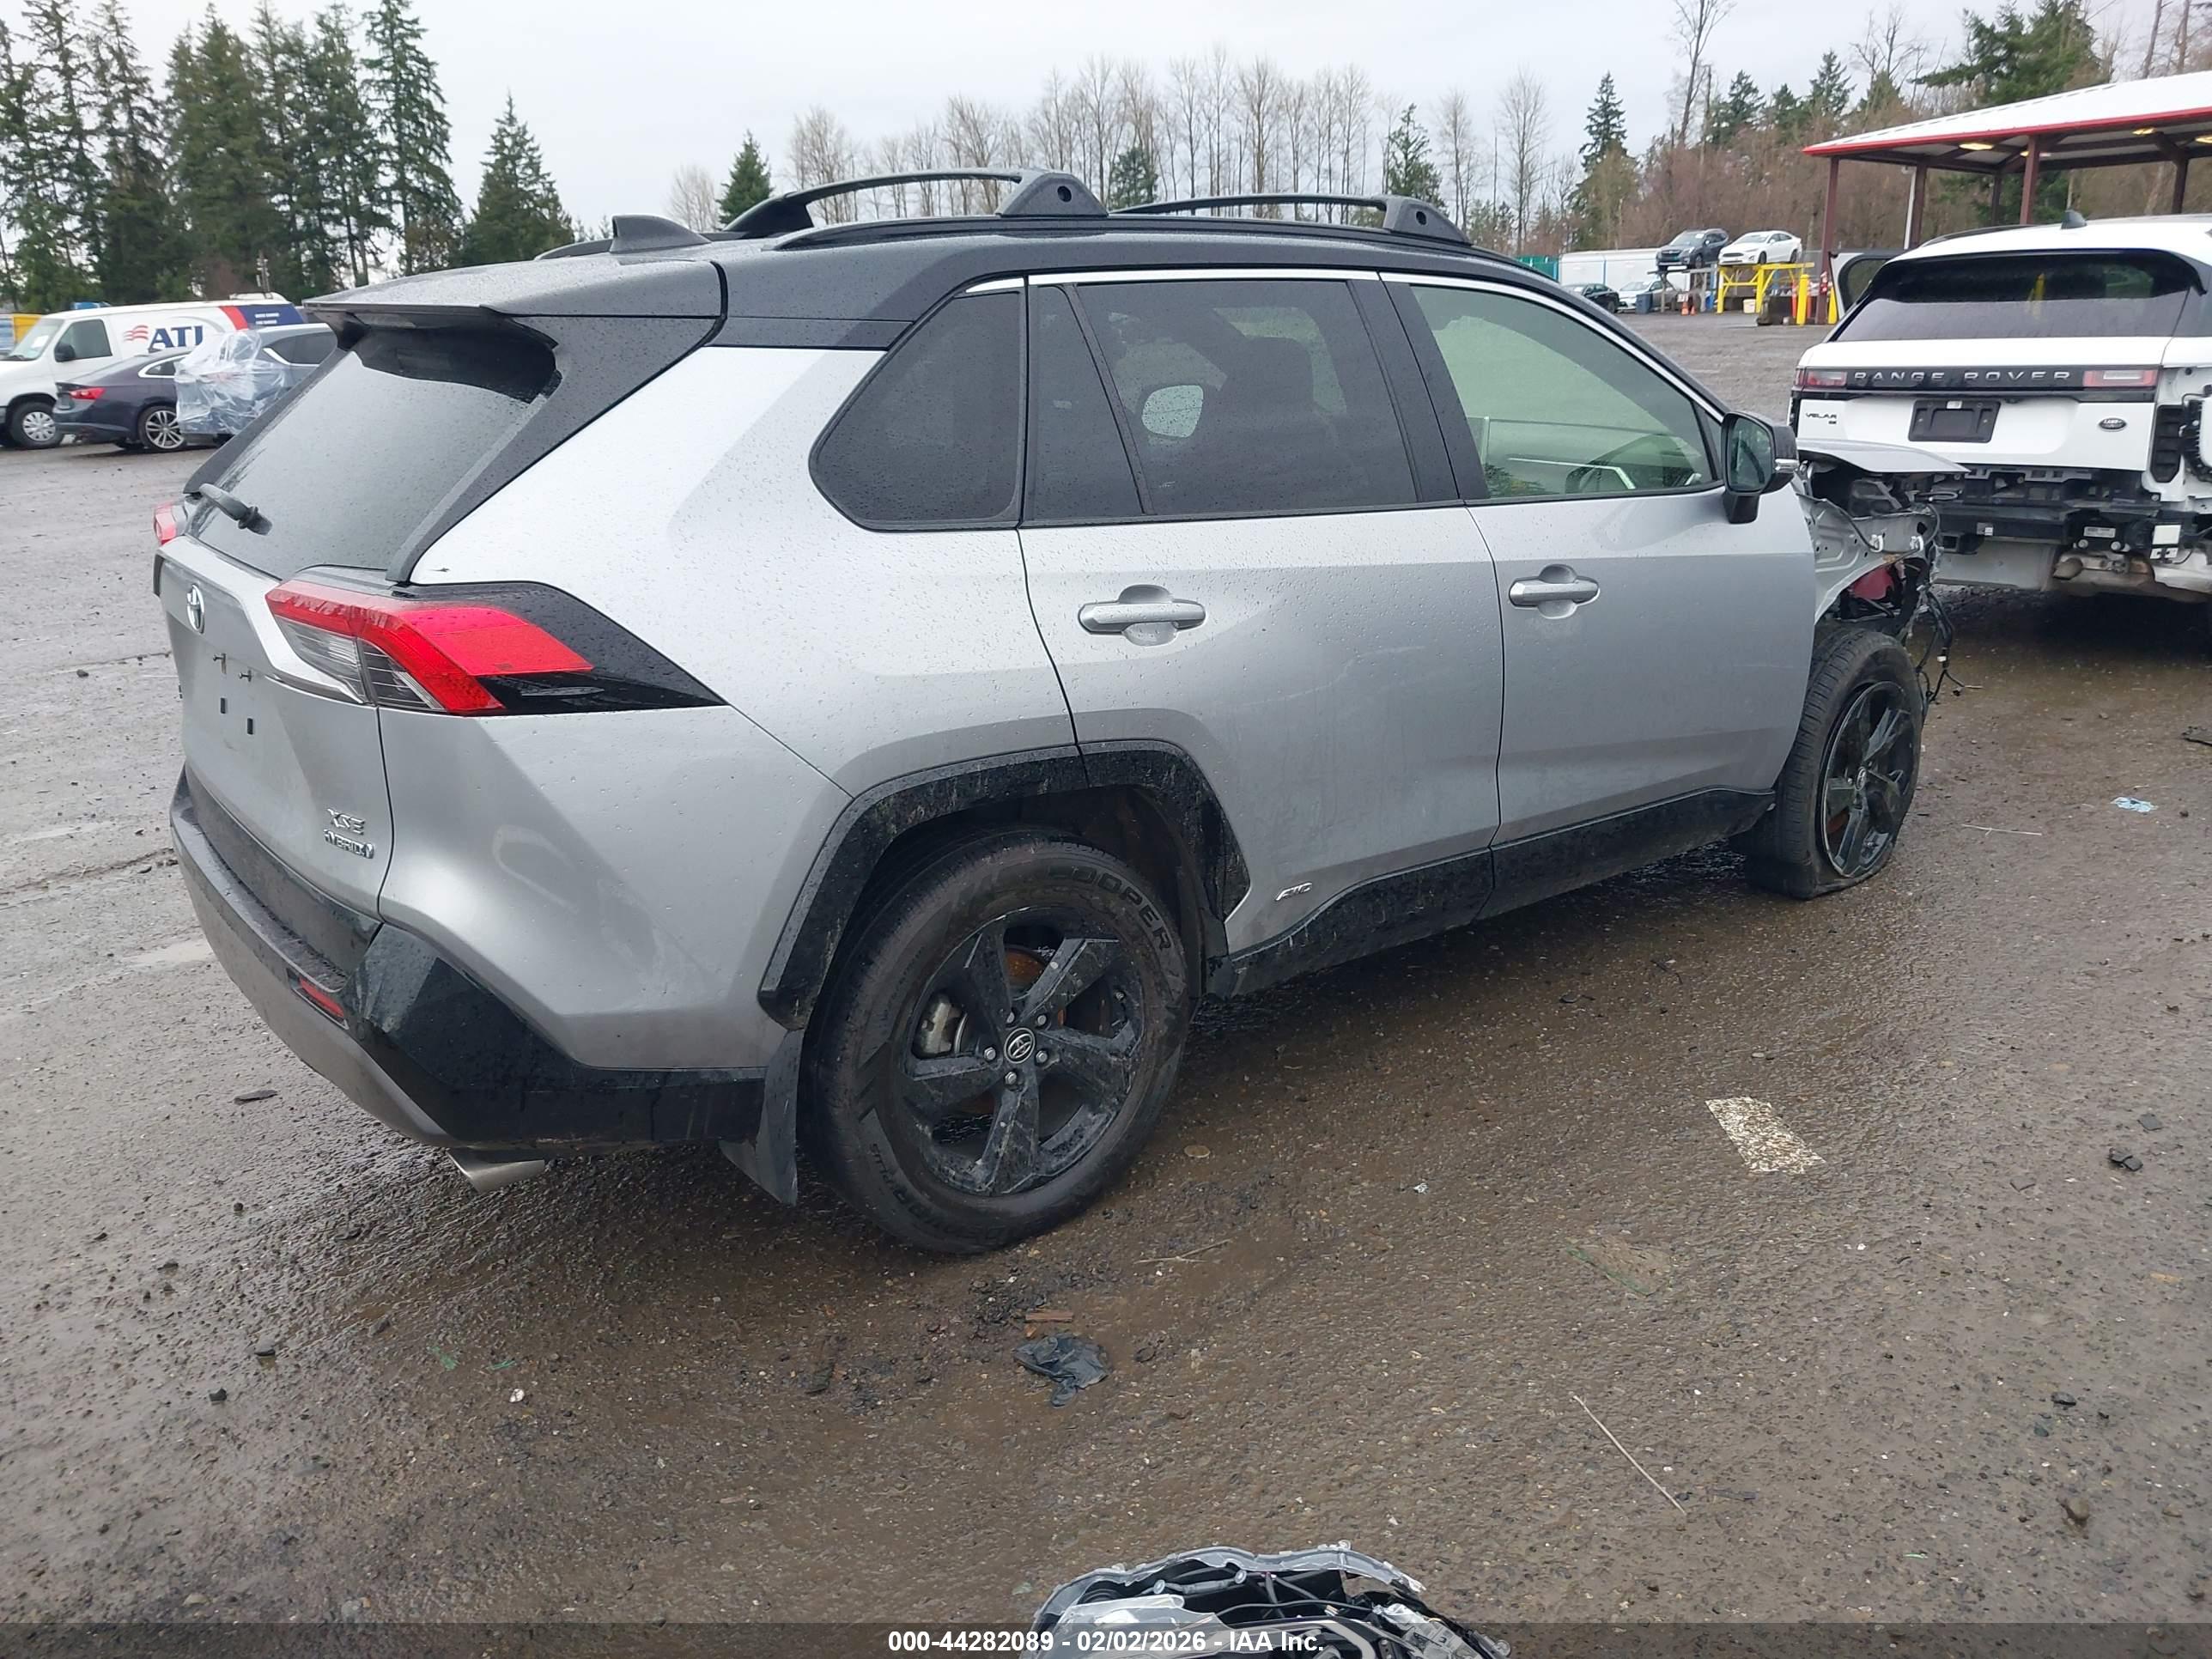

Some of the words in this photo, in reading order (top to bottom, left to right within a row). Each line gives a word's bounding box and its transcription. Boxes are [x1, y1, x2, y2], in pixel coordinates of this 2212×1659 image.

[1854, 371, 1945, 381] RANGE
[1964, 371, 2071, 381] ROVER
[327, 808, 365, 836] XSE
[1048, 864, 1172, 950] COOPER
